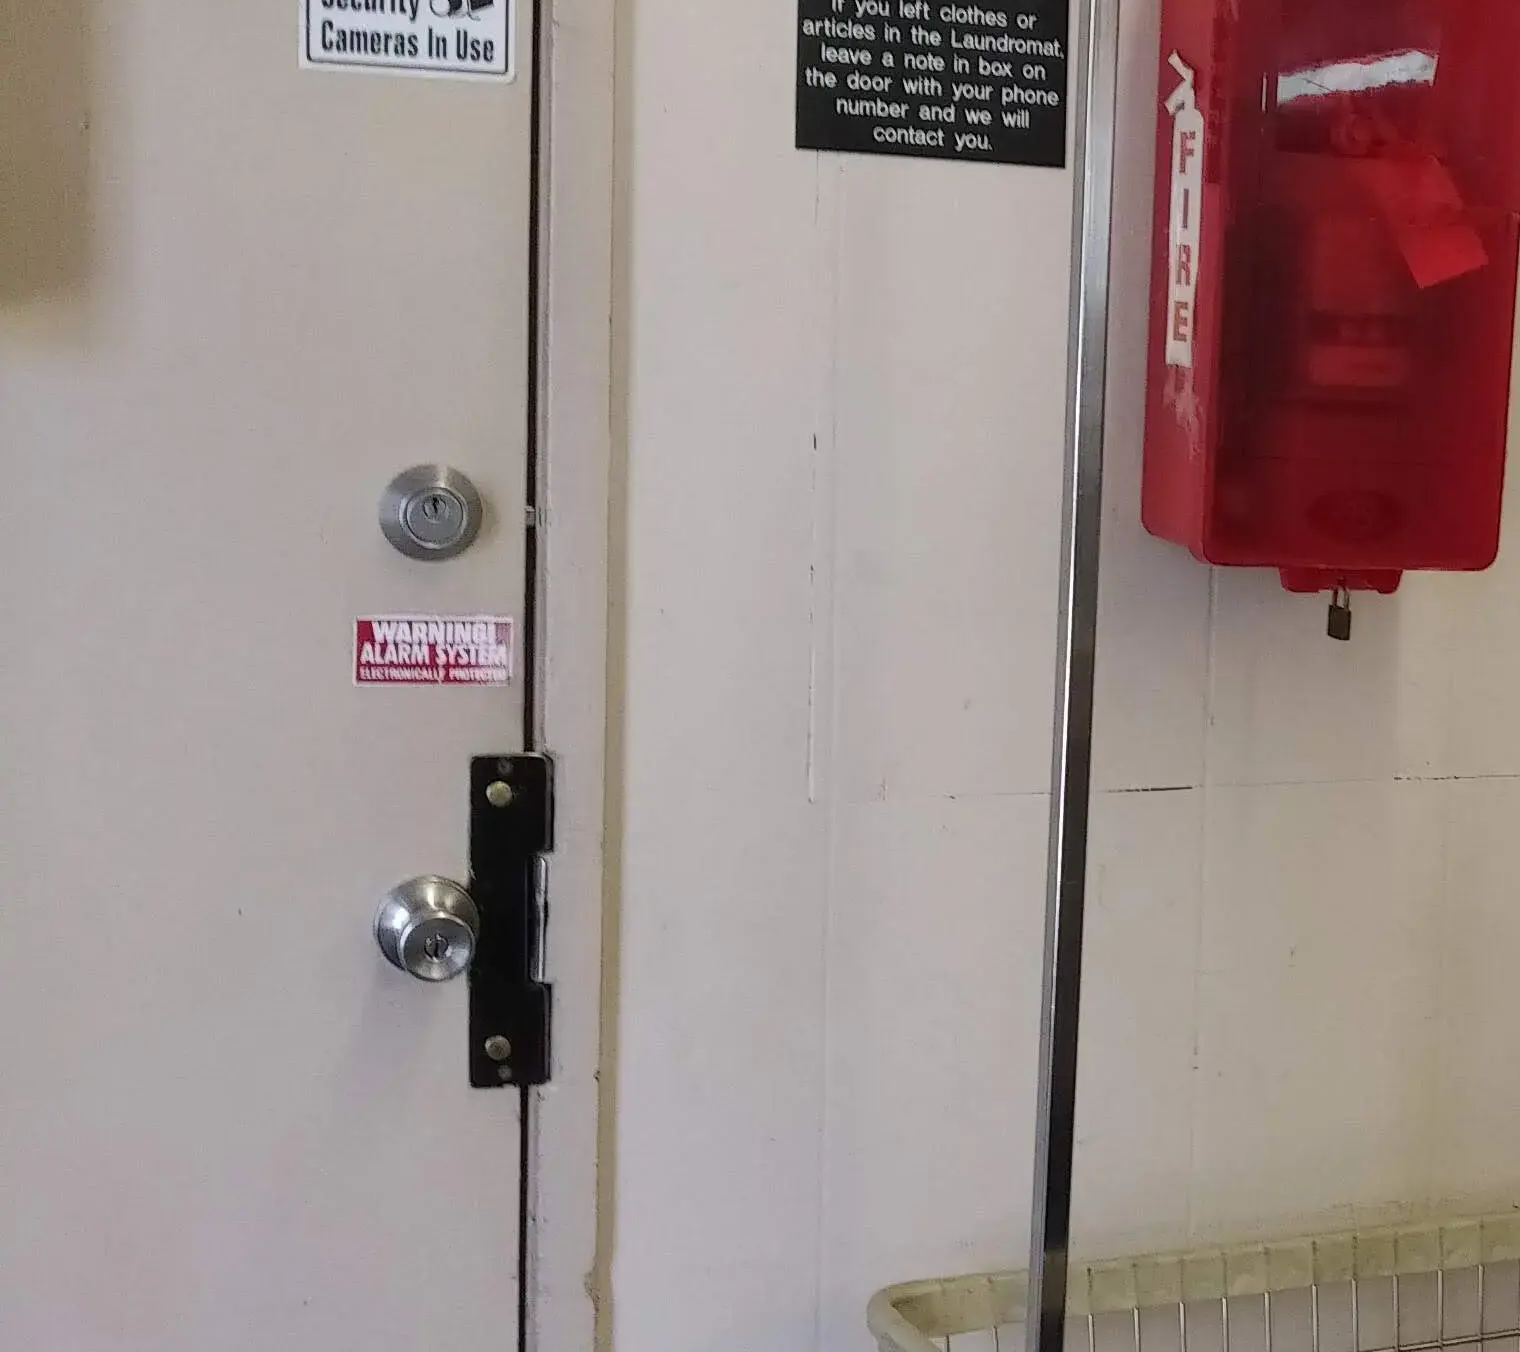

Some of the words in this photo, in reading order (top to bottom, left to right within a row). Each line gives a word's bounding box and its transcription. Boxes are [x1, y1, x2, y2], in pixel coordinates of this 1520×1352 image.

[802, 16, 876, 41] articles
[884, 21, 901, 43] in
[910, 24, 942, 47] the
[939, 4, 1008, 29] clothes
[1016, 12, 1037, 31] or
[321, 19, 418, 58] Cameras
[428, 26, 447, 60] In
[455, 28, 494, 63] Use
[821, 41, 872, 66] leave
[881, 51, 895, 68] a
[903, 52, 945, 73] note
[953, 53, 970, 75] in
[979, 58, 1013, 78] box
[1022, 64, 1046, 81] on
[805, 66, 837, 88] the
[846, 70, 893, 93] door
[903, 75, 942, 97] with
[952, 82, 994, 102] your
[1001, 85, 1060, 107] phone
[836, 96, 909, 120] number
[918, 104, 955, 124] and
[965, 109, 992, 126] we
[1002, 110, 1030, 129] will
[873, 126, 944, 147] contact
[954, 133, 993, 153] you.
[360, 643, 430, 664] ALARM
[435, 644, 507, 666] SYSTEM
